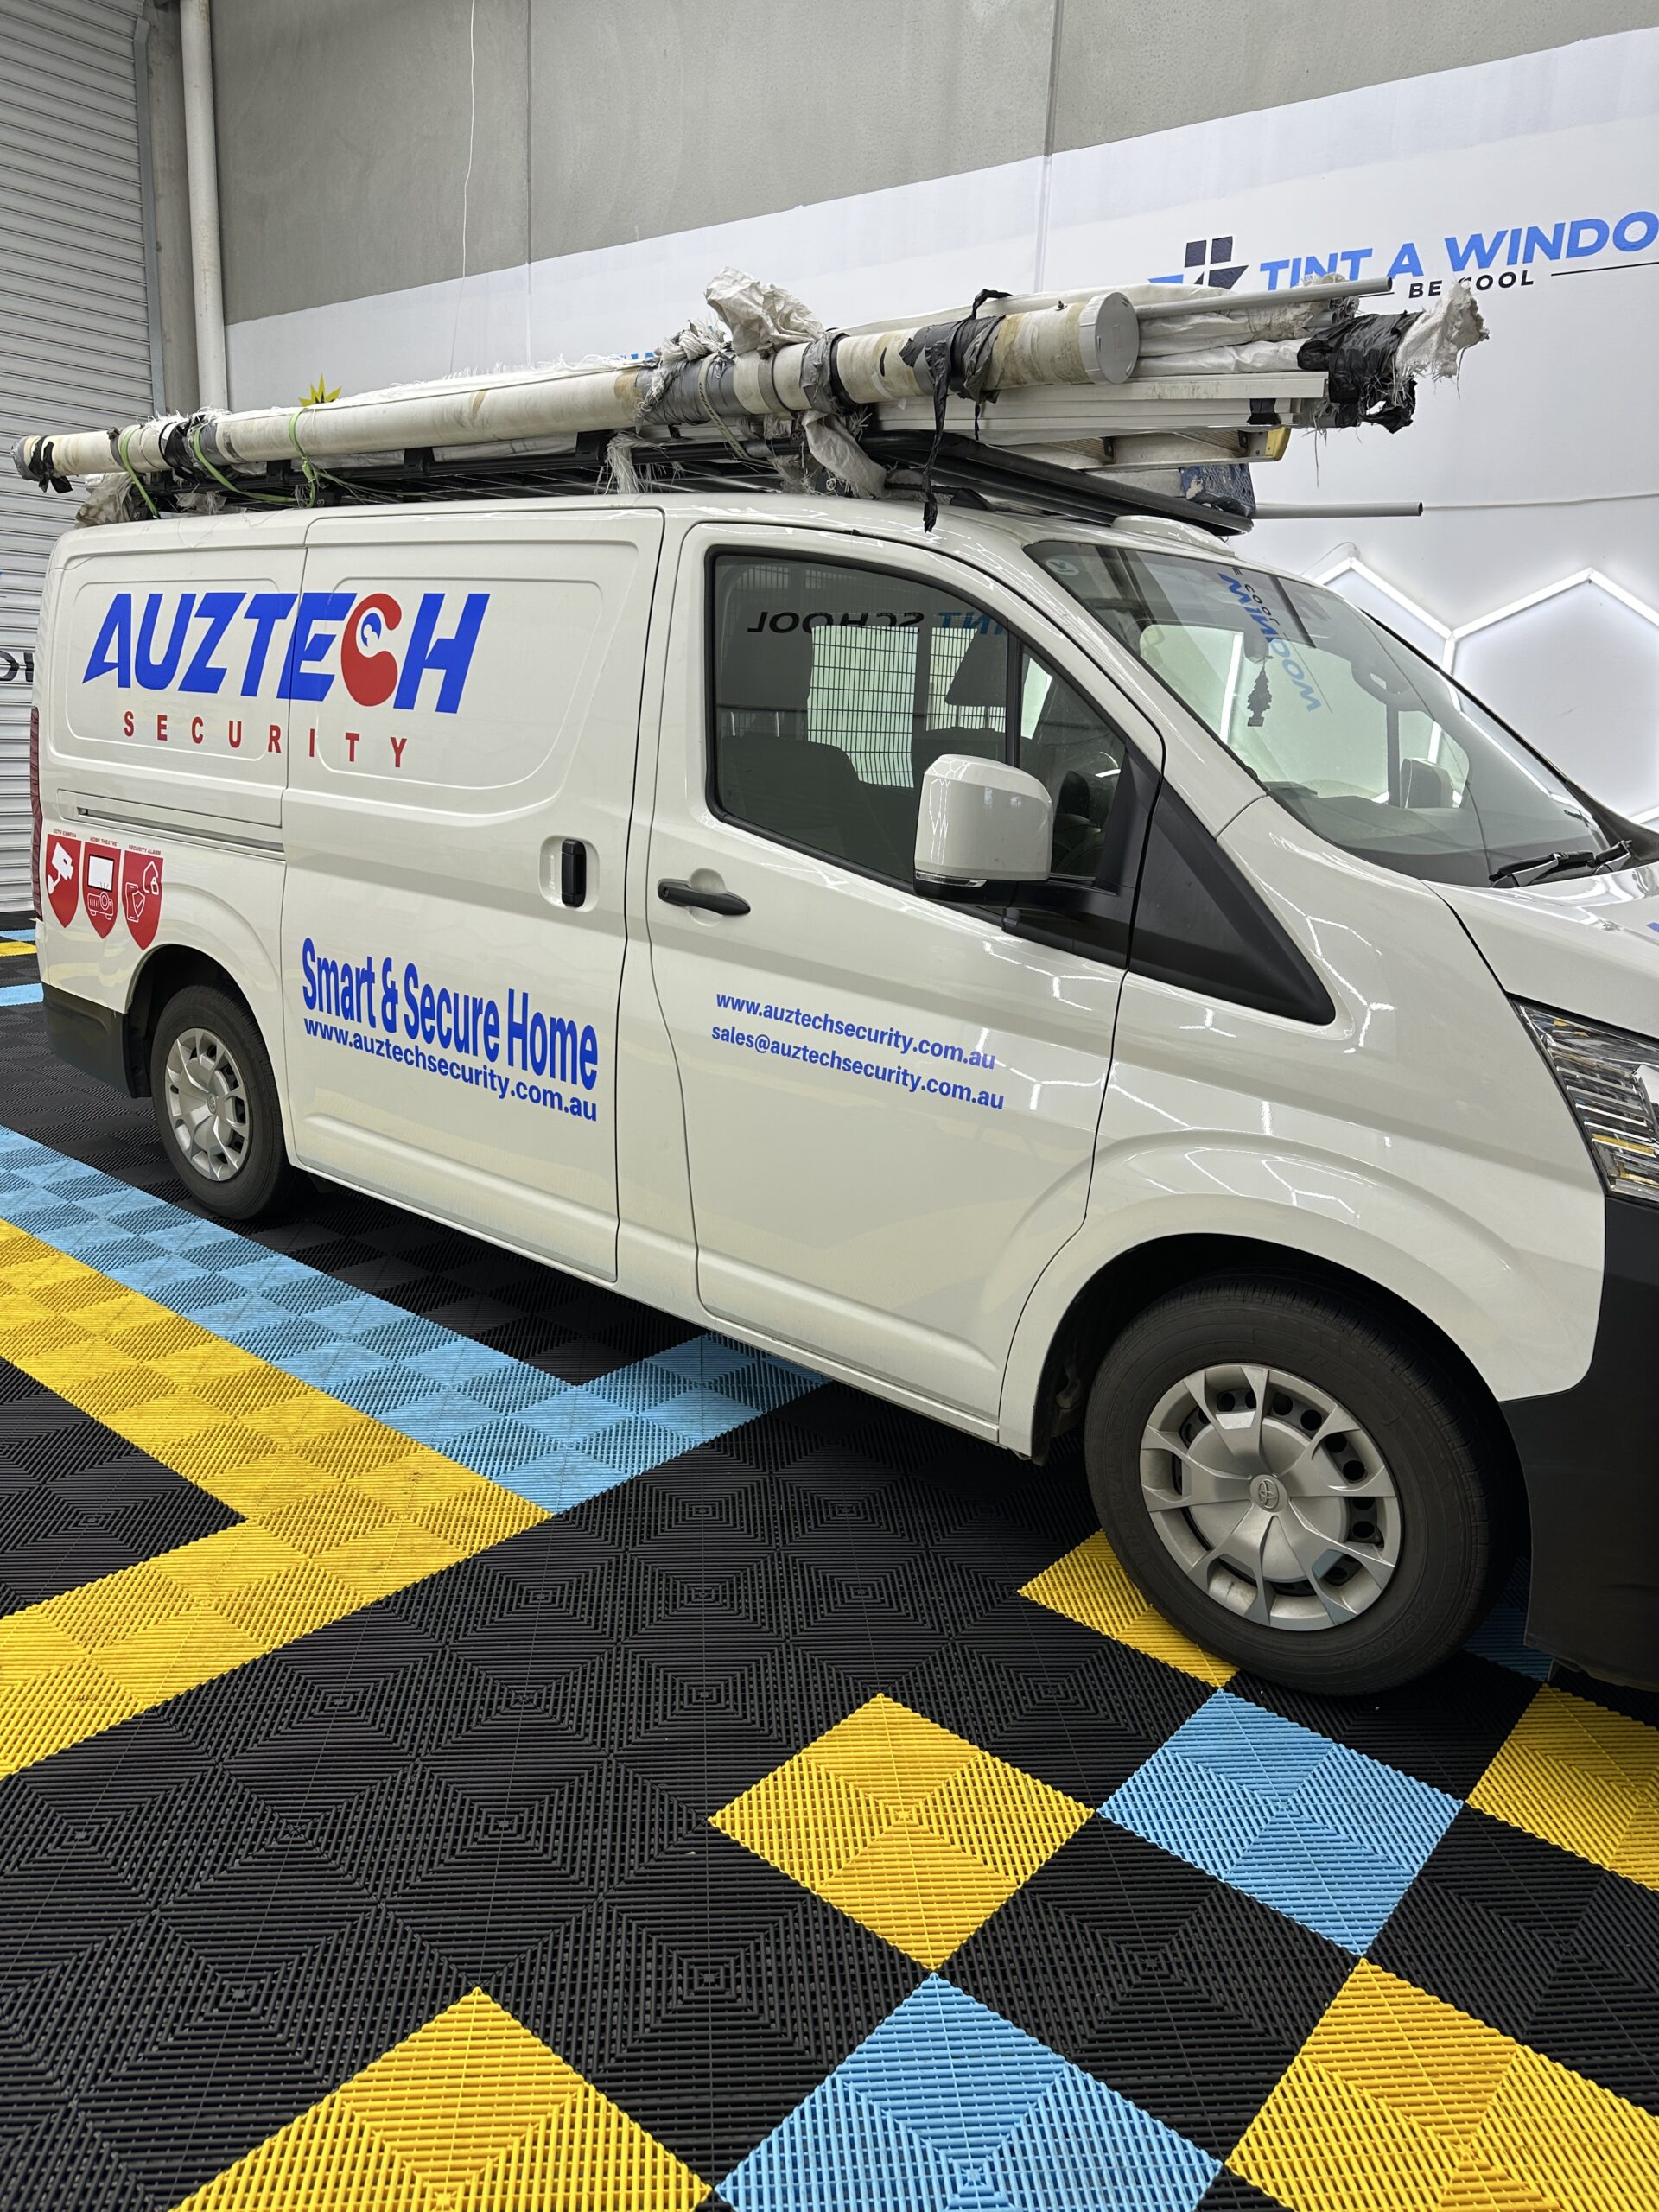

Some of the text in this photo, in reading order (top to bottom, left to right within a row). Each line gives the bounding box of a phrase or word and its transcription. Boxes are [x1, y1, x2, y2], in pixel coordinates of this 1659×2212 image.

[1386, 242, 1424, 279] A
[1444, 210, 1659, 272] WINDO
[1408, 280, 1443, 299] BE
[82, 592, 491, 715] AUZTECH
[123, 710, 408, 768] SECURITY
[129, 844, 147, 853] SECURITY
[302, 937, 598, 1090] Smart & Secure Home
[716, 993, 996, 1070] www.auztechsecurity.com.au
[304, 1018, 597, 1122] www.auztechsecurity.com.au
[711, 1027, 1004, 1109] sales@auztechsecurity.com.au
